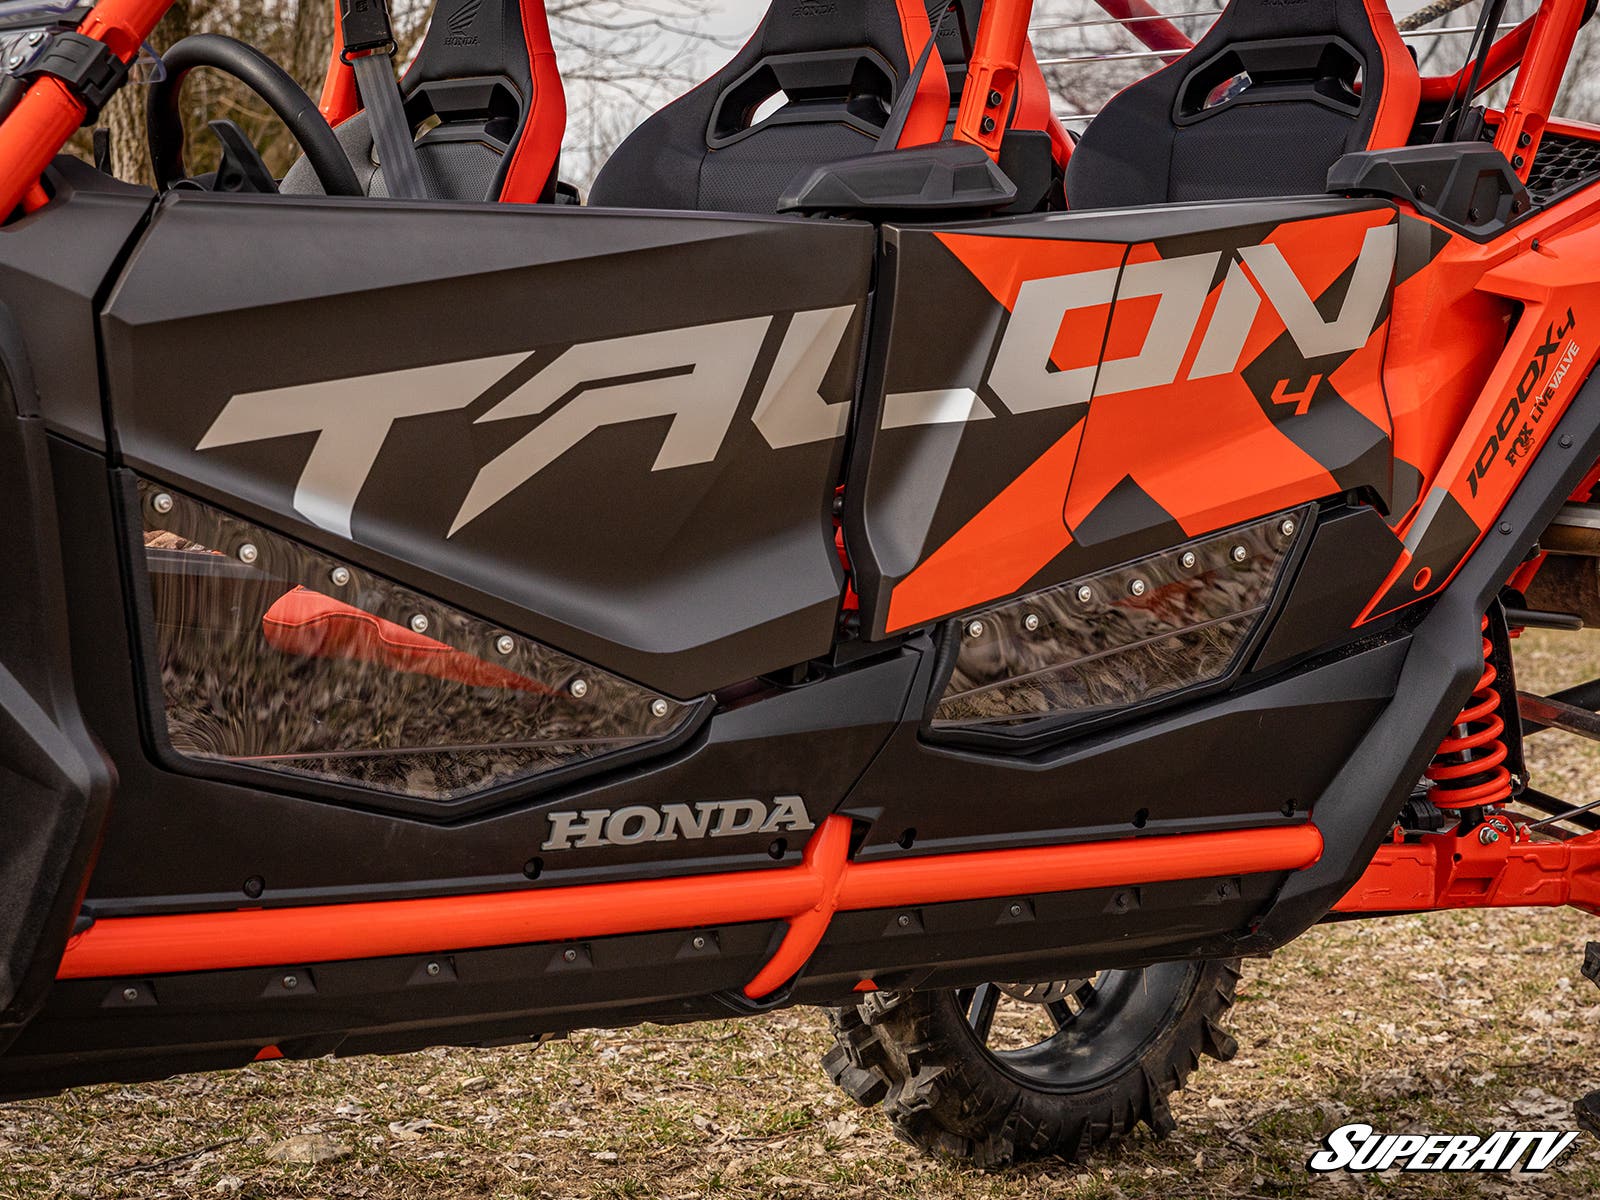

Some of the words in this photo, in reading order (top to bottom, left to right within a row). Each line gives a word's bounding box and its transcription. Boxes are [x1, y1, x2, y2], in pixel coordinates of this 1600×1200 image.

[443, 36, 480, 47] HONDA
[196, 224, 1397, 540] TALON
[1270, 373, 1324, 416] 4
[1466, 306, 1576, 499] 1000X4
[1505, 422, 1535, 468] FOX
[541, 796, 816, 850] HONDA
